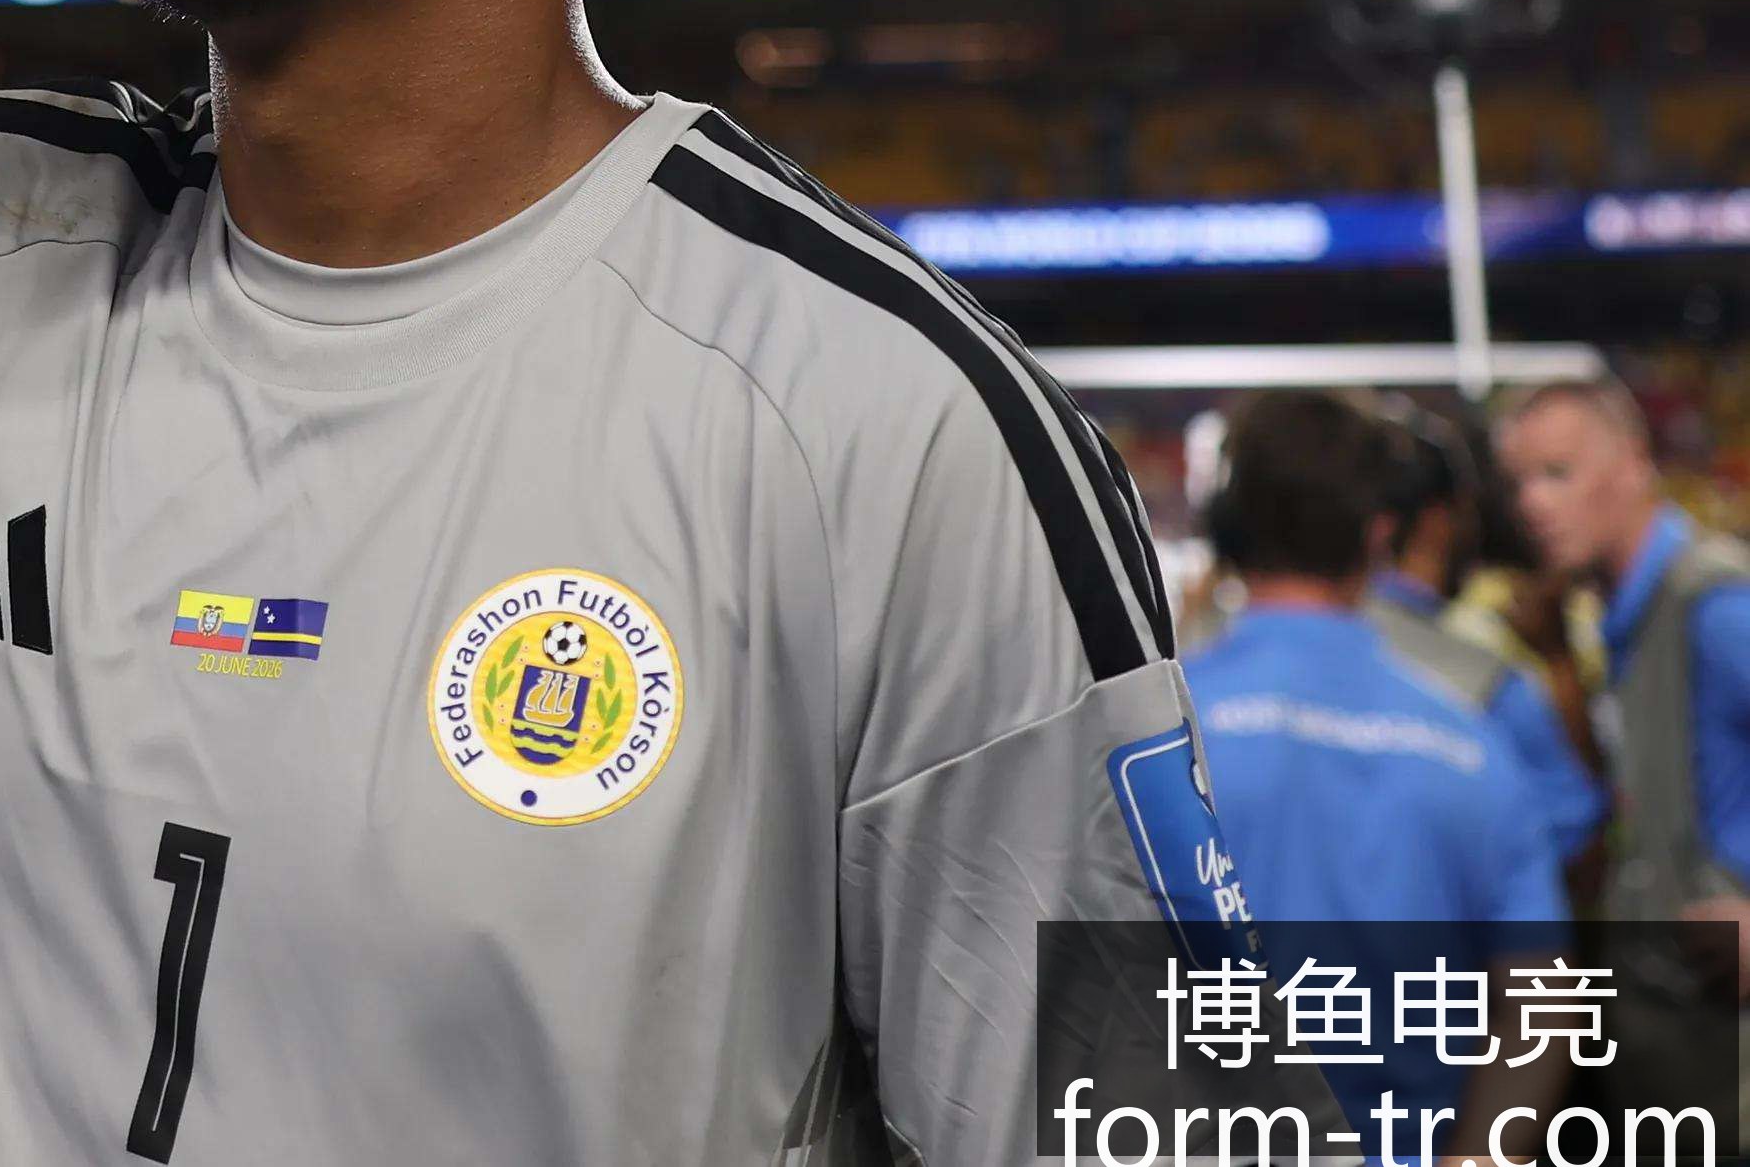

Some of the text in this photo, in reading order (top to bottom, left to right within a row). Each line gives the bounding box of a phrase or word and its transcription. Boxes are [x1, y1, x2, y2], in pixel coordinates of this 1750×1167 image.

[198, 654, 283, 679] 20 JUNE 2026
[440, 579, 672, 791] Federashon Futbòl Kòrsou
[127, 822, 231, 1165] 1
